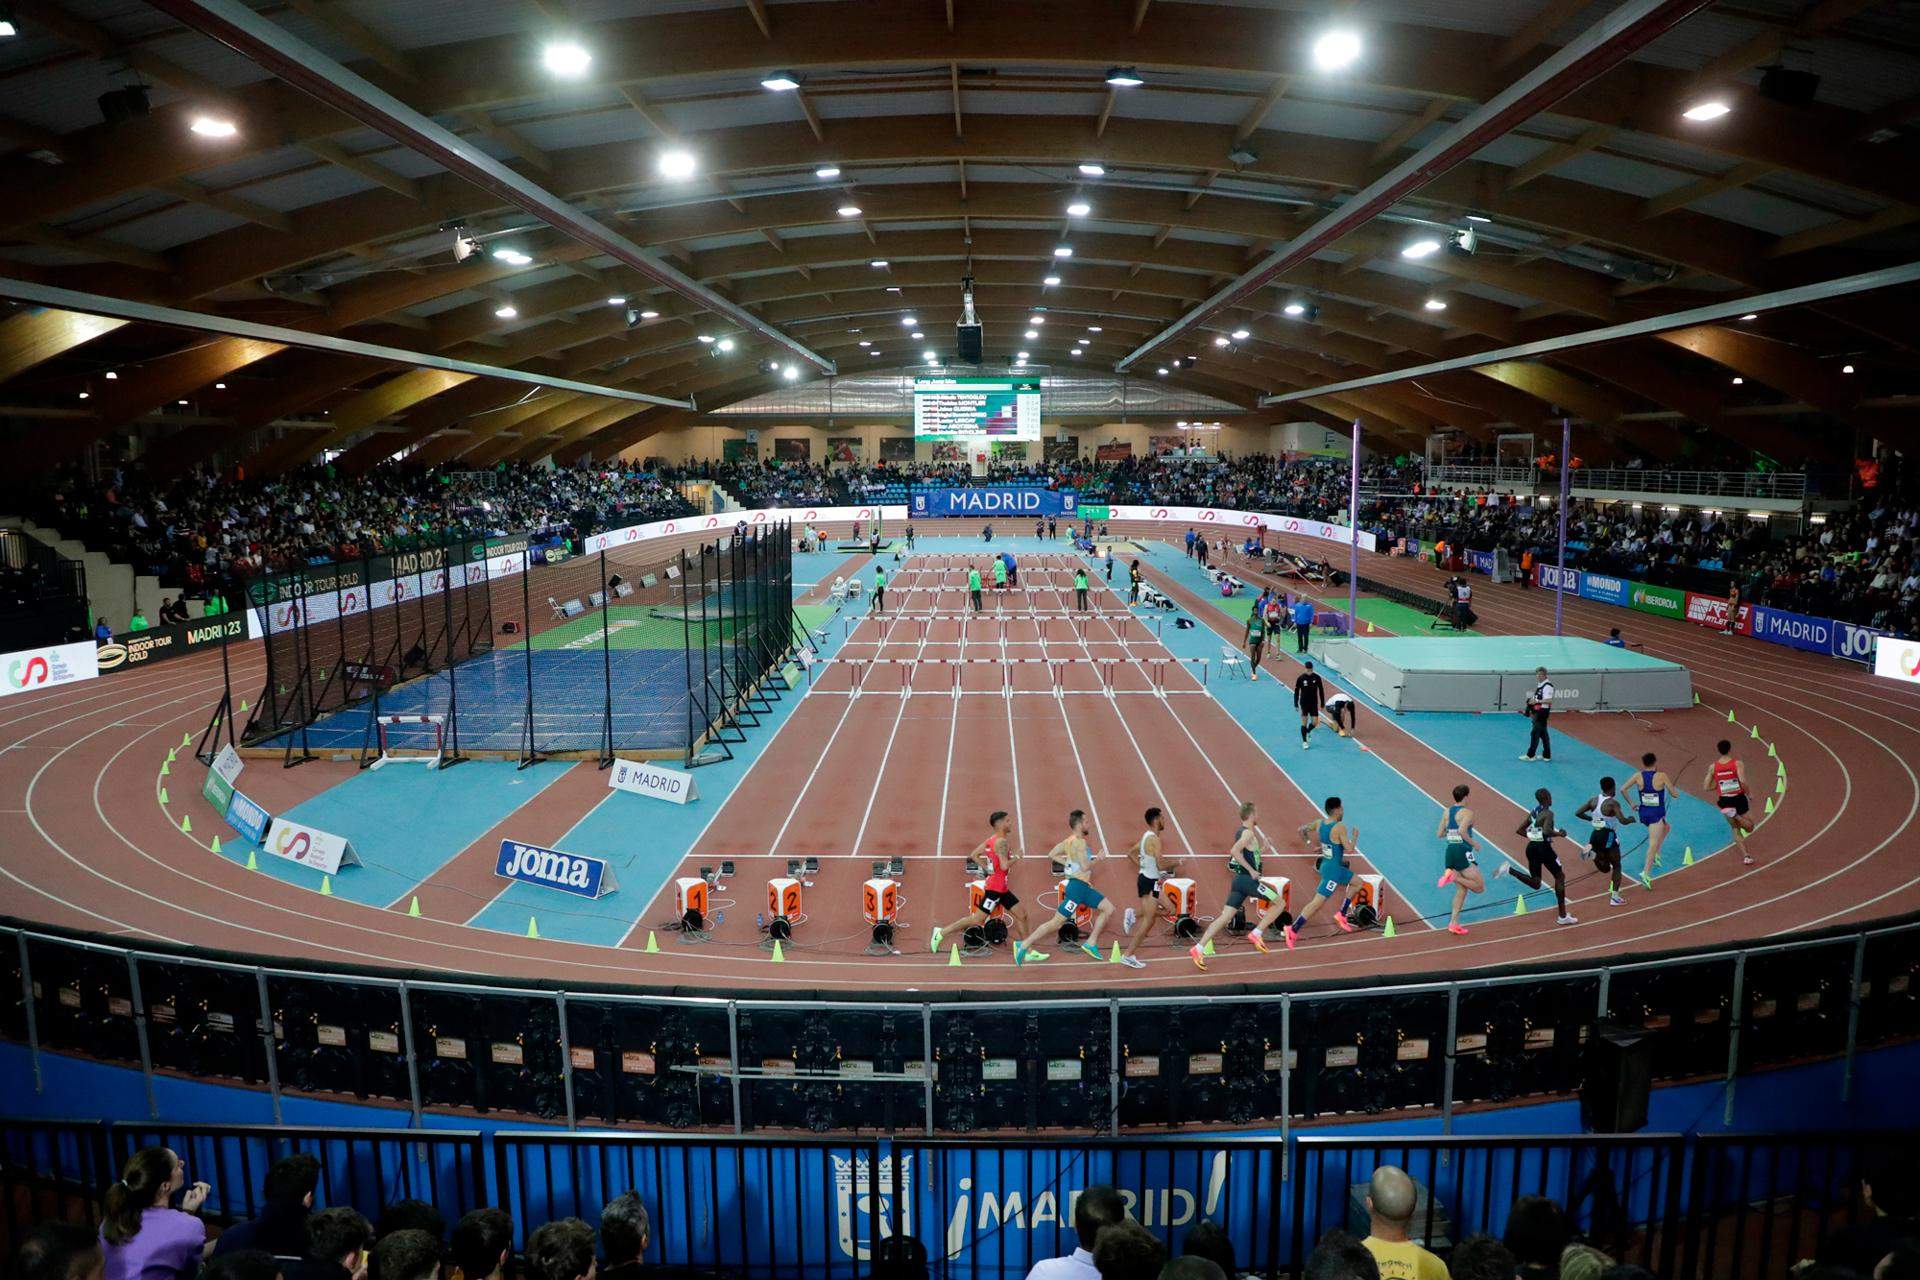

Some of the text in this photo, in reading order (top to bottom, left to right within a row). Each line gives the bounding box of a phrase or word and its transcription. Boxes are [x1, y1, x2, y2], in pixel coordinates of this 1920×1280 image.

[950, 492, 1040, 510] MADRID
[435, 548, 448, 568] 2
[1480, 557, 1493, 569] MAD
[315, 577, 336, 592] TOUR
[1645, 595, 1677, 609] IBERDROLA
[1710, 601, 1748, 620] RFA
[227, 621, 241, 635] 23
[1771, 617, 1827, 644] MADRID
[128, 640, 154, 653] INDOOR
[154, 636, 172, 647] TOUR
[128, 650, 148, 662] GOLD
[632, 771, 680, 794] MADRID
[693, 890, 701, 909] 1
[787, 891, 797, 912] 2
[866, 891, 875, 911] 3
[885, 891, 894, 911] 3
[1067, 902, 1074, 911] 3
[947, 1149, 1227, 1261] ¡MARID!
